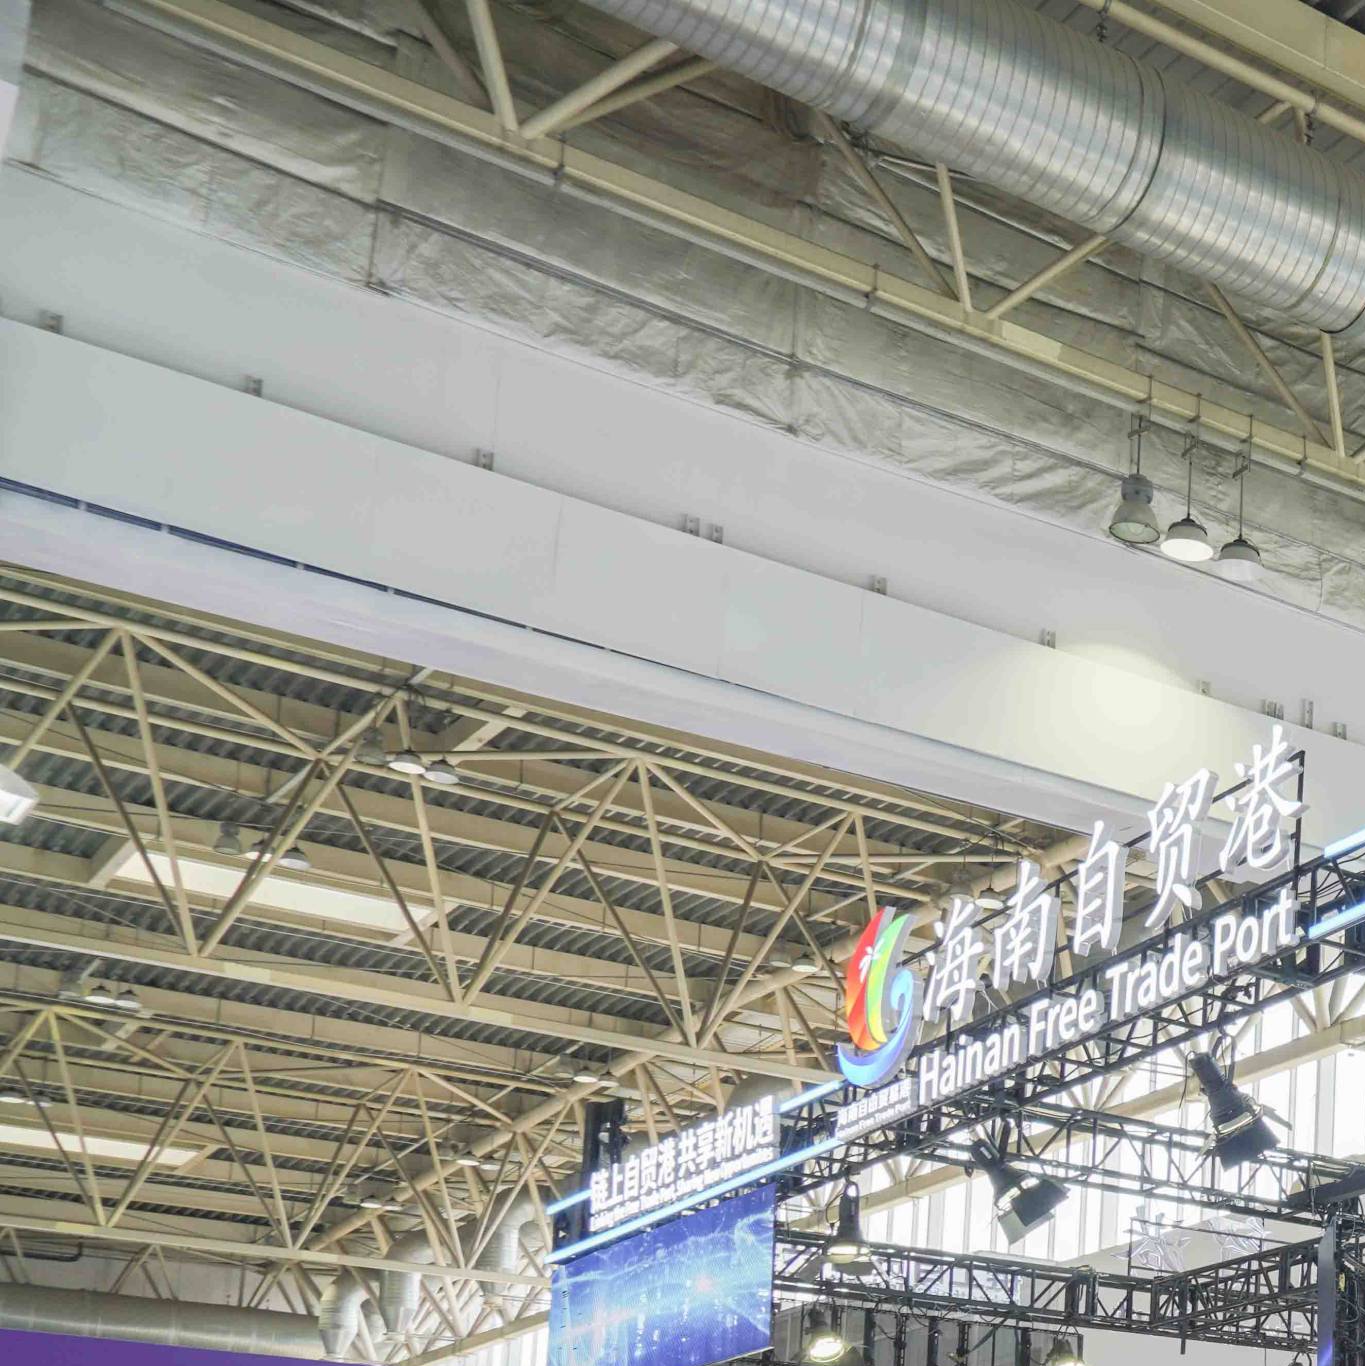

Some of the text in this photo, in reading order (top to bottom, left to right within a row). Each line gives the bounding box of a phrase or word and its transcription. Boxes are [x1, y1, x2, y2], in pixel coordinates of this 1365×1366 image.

[920, 893, 1297, 1100] Hainan Free Trade Port
[924, 724, 1302, 1022] 海南自贸港
